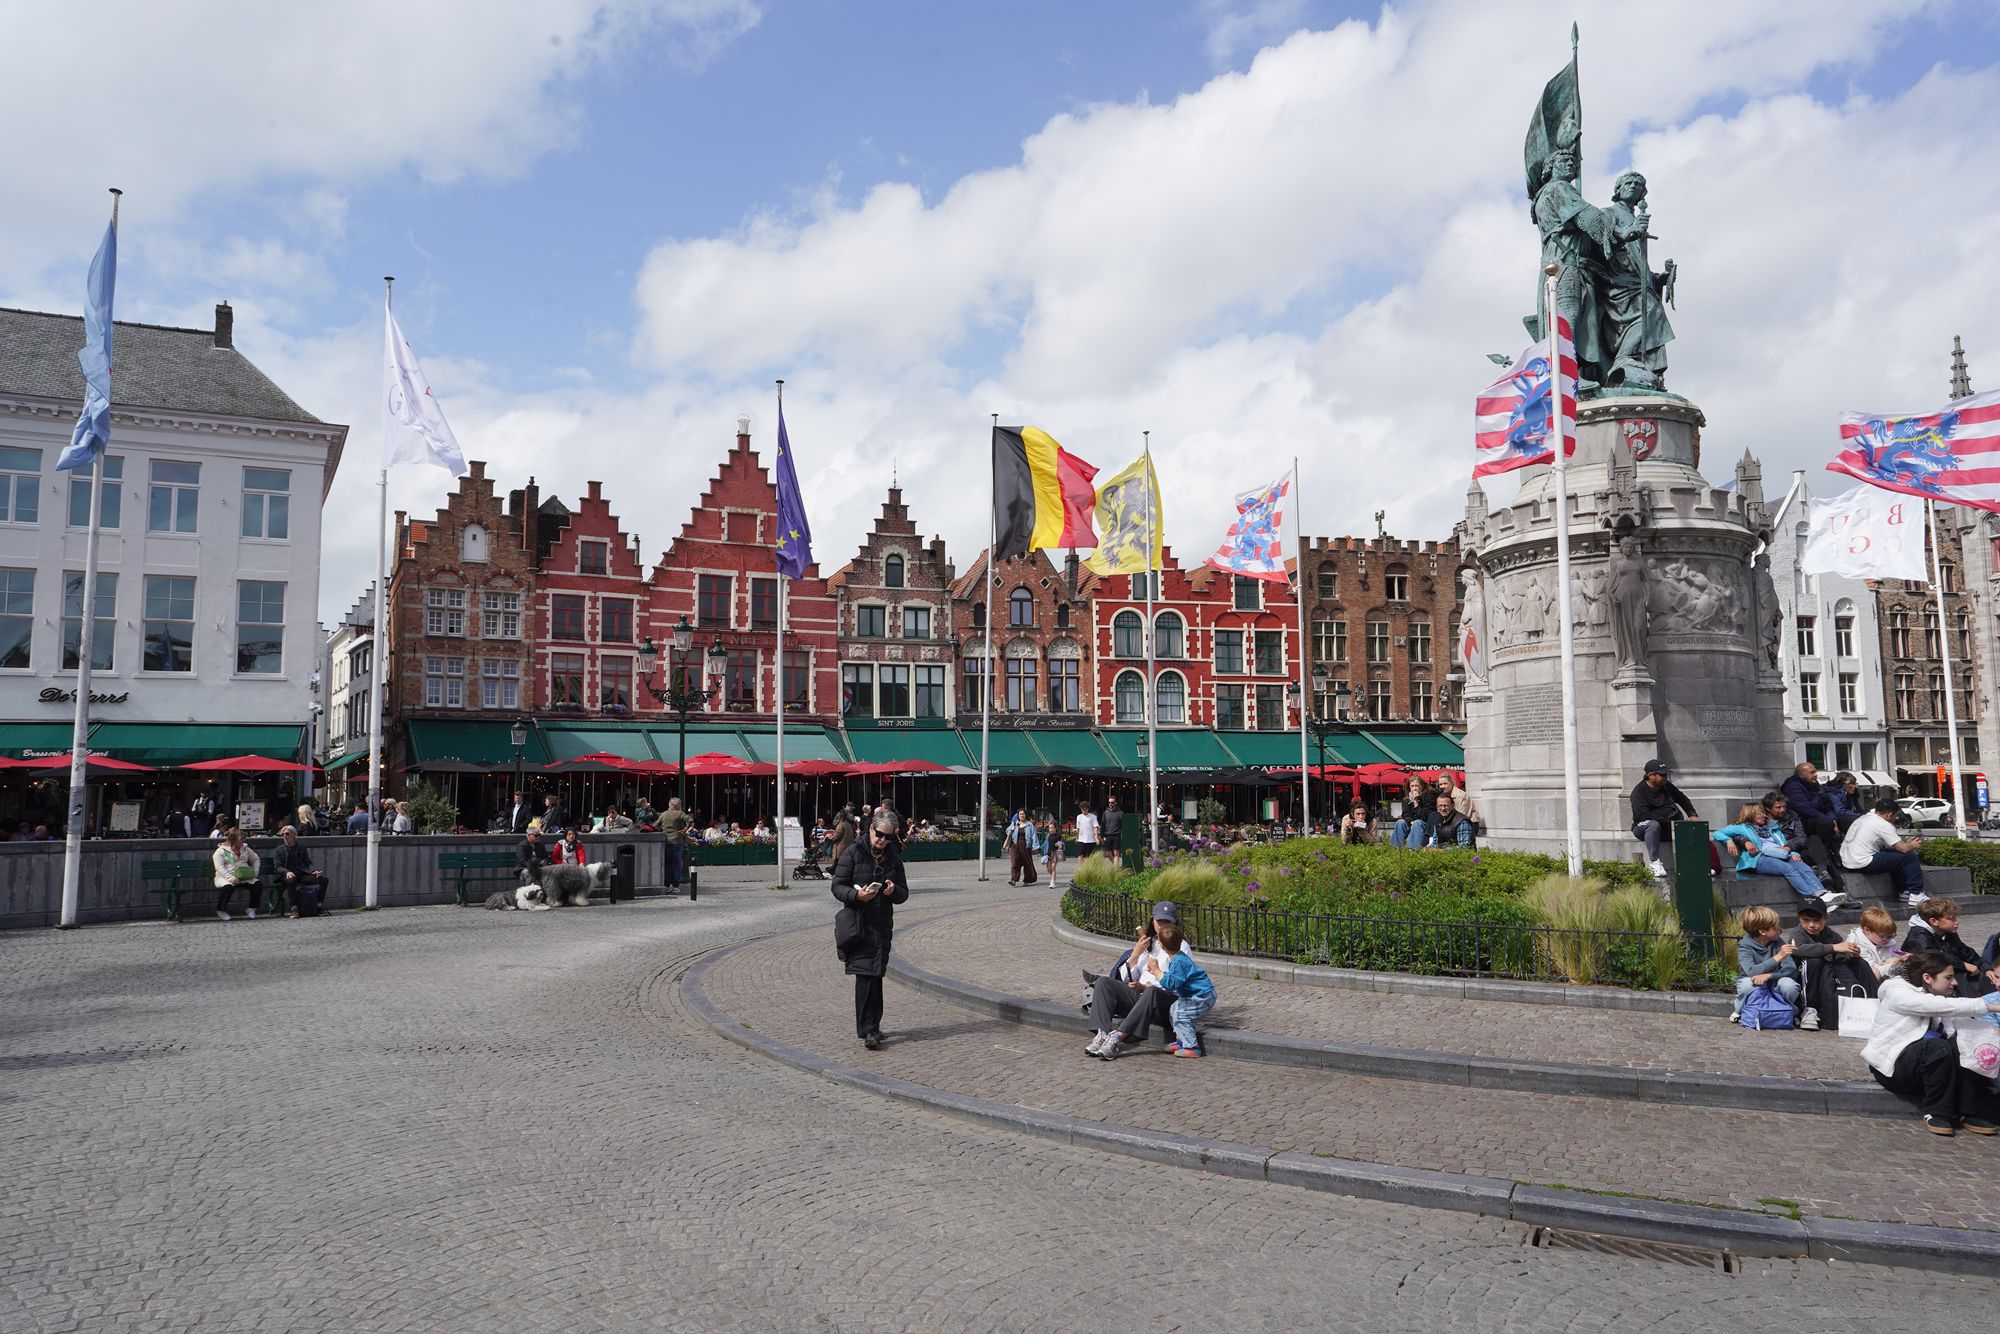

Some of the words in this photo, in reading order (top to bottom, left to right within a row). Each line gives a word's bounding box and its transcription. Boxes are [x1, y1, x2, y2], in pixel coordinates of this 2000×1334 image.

[38, 687, 70, 703] De
[877, 720, 894, 728] SINT
[895, 720, 915, 728] JORIS
[22, 749, 65, 757] Brasserie
